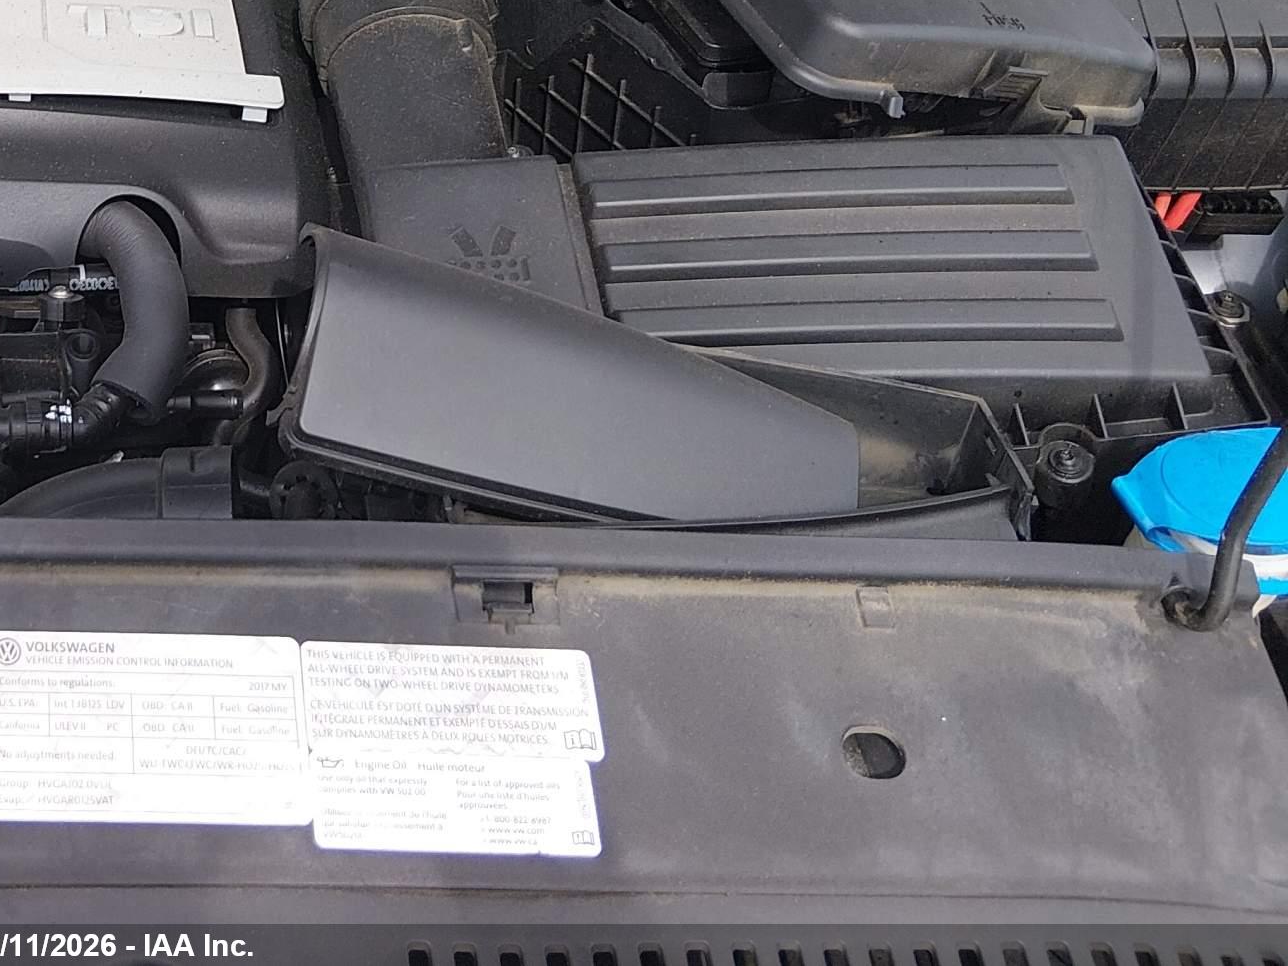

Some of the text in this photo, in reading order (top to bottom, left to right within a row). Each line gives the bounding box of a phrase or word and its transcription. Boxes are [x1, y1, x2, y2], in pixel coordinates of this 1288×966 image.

[25, 641, 115, 654] VOLKSWAGEN
[25, 655, 234, 668] VEHICLE EMISSION CONTROL INFORMATION
[307, 649, 545, 667] THIS VEHICLE IS EQUIPPED WITH A PERMANENT
[307, 663, 365, 674] ALL-WHEEL
[367, 664, 398, 675] DRIVE
[399, 666, 438, 677] SYSTEM
[440, 667, 465, 678] AND
[466, 667, 476, 678] IS
[478, 668, 518, 679] EXEMPT
[520, 669, 550, 680] FROM
[0, 676, 45, 687] Conforms
[48, 677, 58, 687] to
[248, 682, 289, 692] 2017 MY
[309, 676, 352, 688] TESTING
[353, 677, 371, 689] ON
[373, 678, 439, 690] TWO-WHEEL
[440, 680, 472, 691] DRIVE
[106, 700, 126, 710] LDV
[247, 703, 289, 714] Gasoline
[376, 700, 393, 711] EST
[498, 705, 513, 715] DE
[514, 706, 590, 718] TRANSMISSION
[106, 722, 120, 732] PC
[367, 714, 427, 726] PERMANENT
[428, 716, 441, 727] ET
[312, 728, 333, 738] SUR
[431, 730, 460, 742] DEUX
[462, 731, 496, 743] ROUES
[355, 759, 407, 772] Engine Oil
[417, 762, 486, 773] Huile moteur
